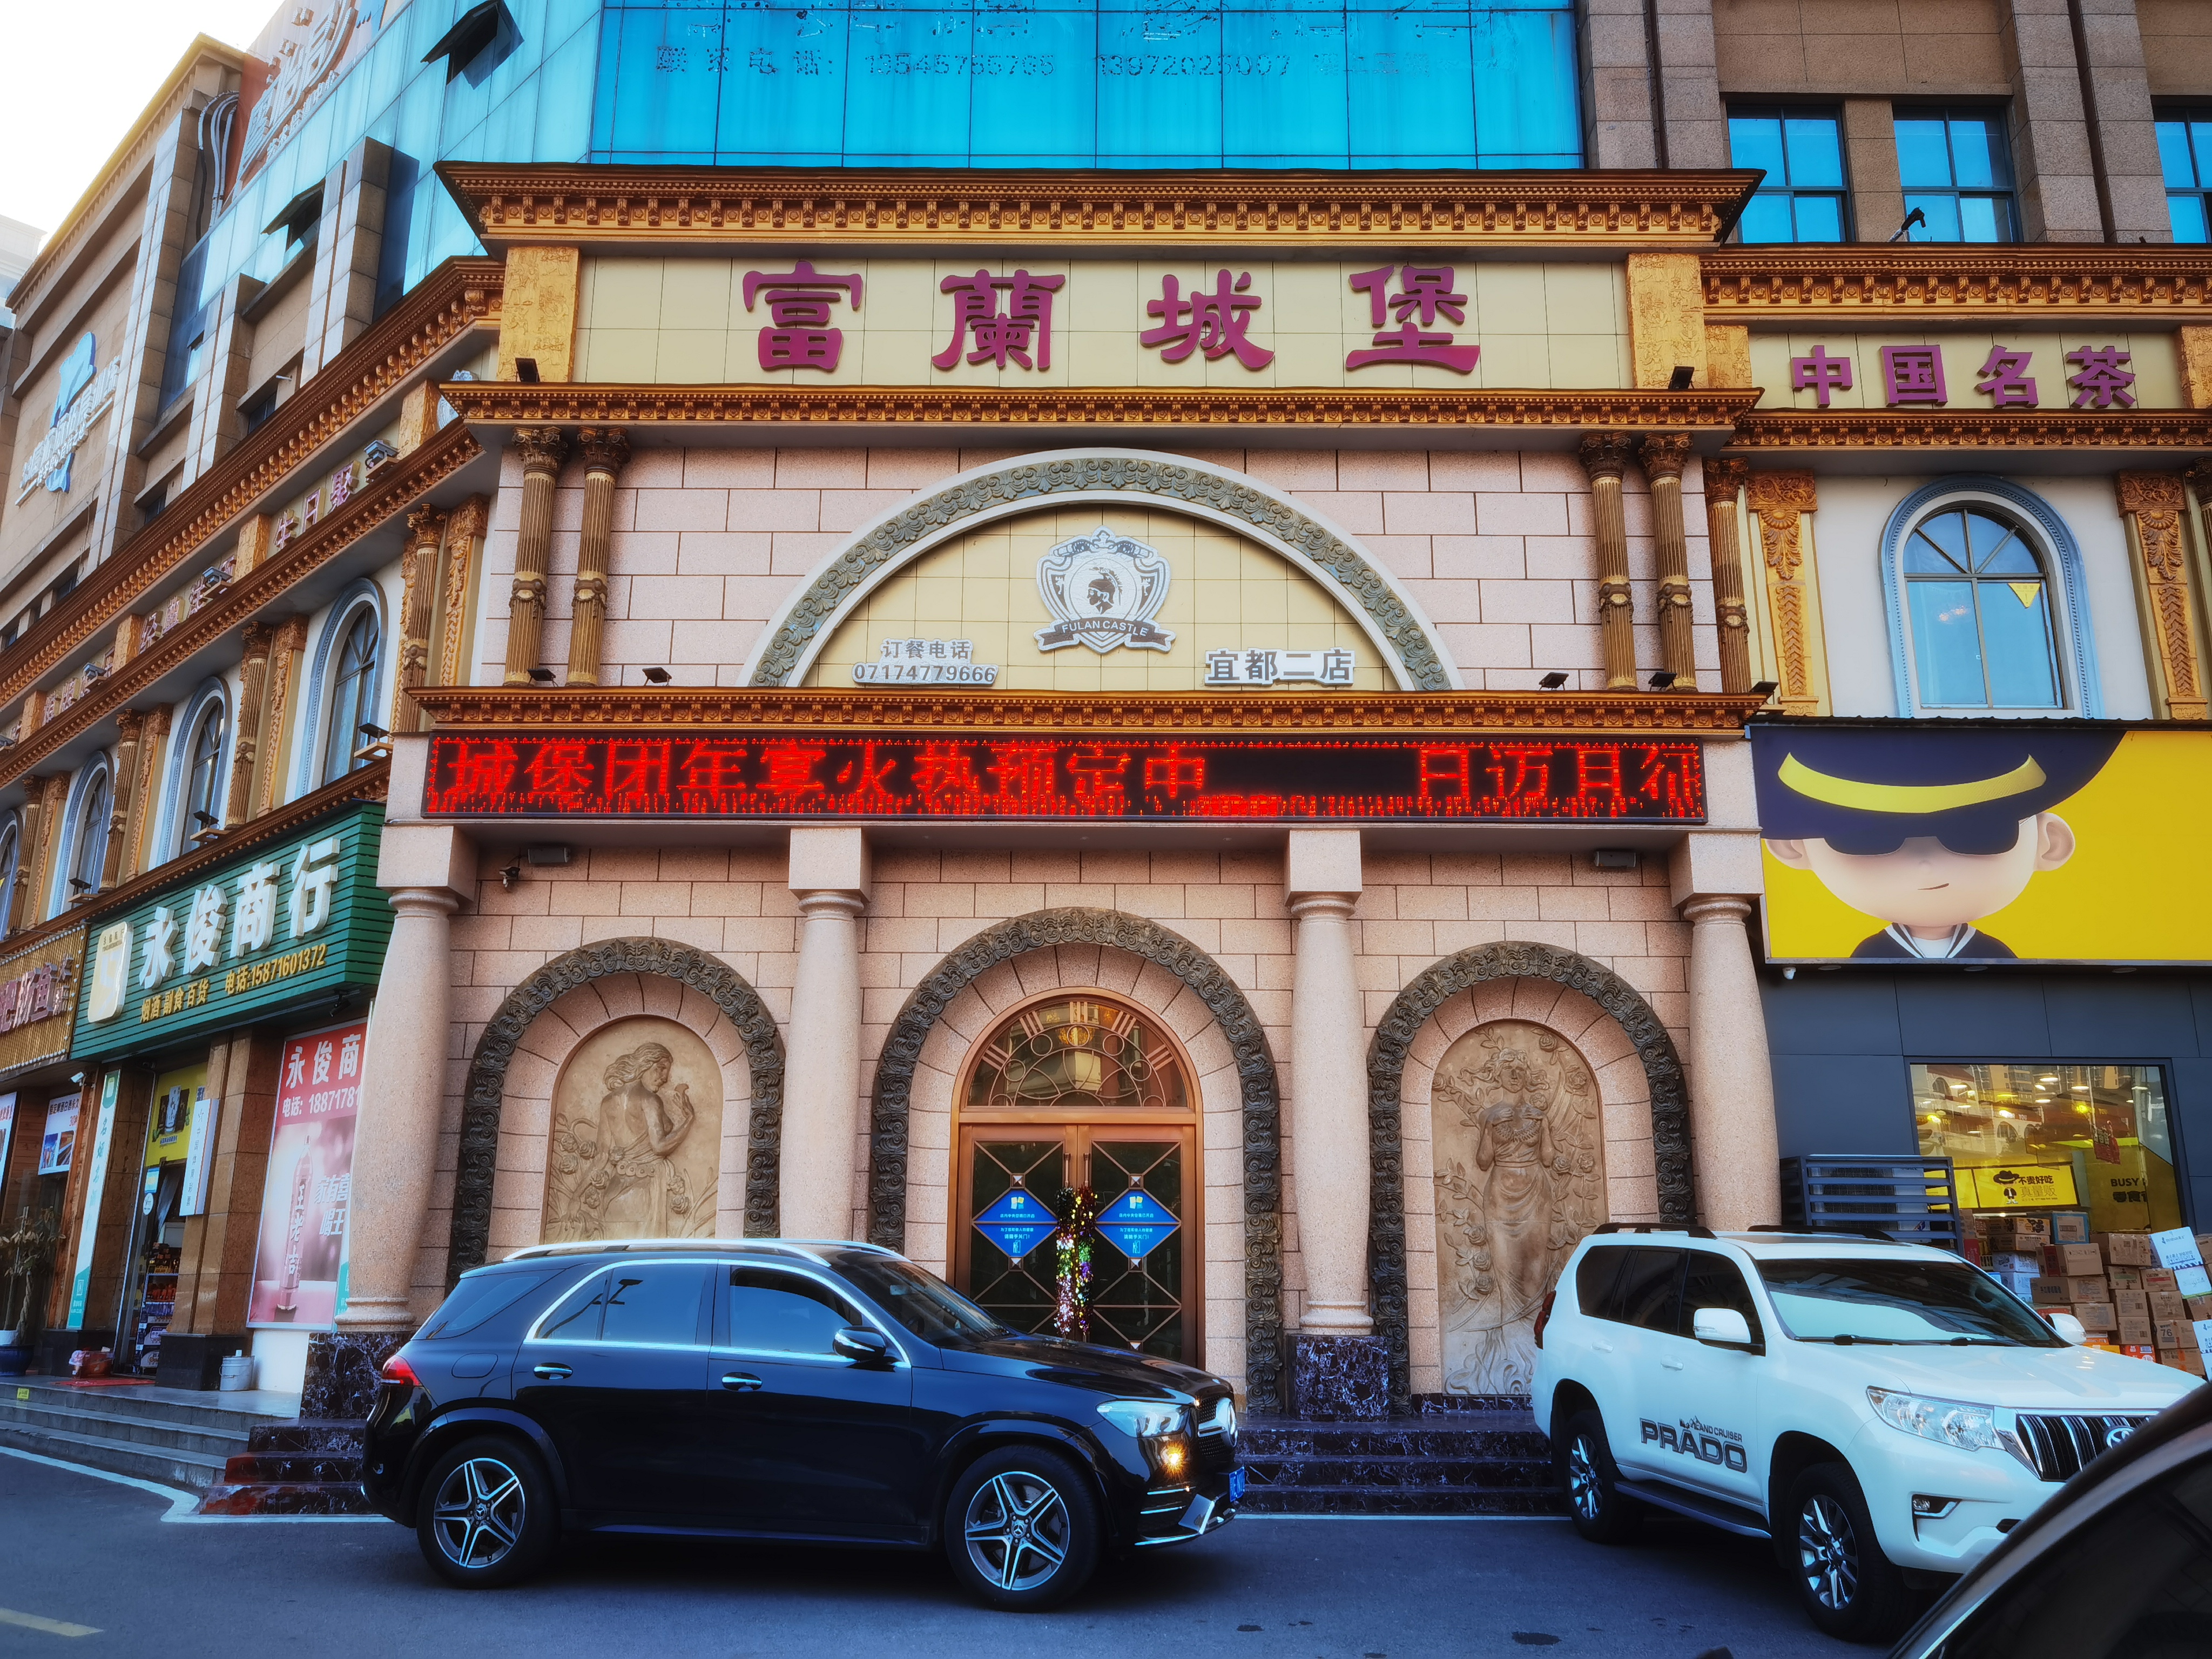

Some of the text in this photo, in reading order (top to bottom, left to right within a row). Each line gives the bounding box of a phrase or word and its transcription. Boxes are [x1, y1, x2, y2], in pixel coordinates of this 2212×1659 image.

[1791, 345, 2136, 408] 中国名茶
[1062, 621, 1149, 637] FULAN CASTLE
[882, 640, 970, 659] 订餐电话
[854, 664, 996, 682] 07174779666
[1209, 648, 1353, 684] 宜都二店
[139, 837, 341, 990] 永俊商行
[286, 1034, 361, 1089] 永俊商
[314, 1172, 350, 1204] 家有喜
[2018, 1175, 2054, 1185] 不贵好吃
[2020, 1185, 2058, 1198] 真量贩
[2110, 1178, 2140, 1187] BUSY
[287, 1184, 305, 1274] 王老吉
[319, 1208, 346, 1236] 喝王
[2160, 1328, 2173, 1337] 76
[1639, 1417, 1748, 1474] PRADO
[1714, 1426, 1743, 1442] CRUISER
